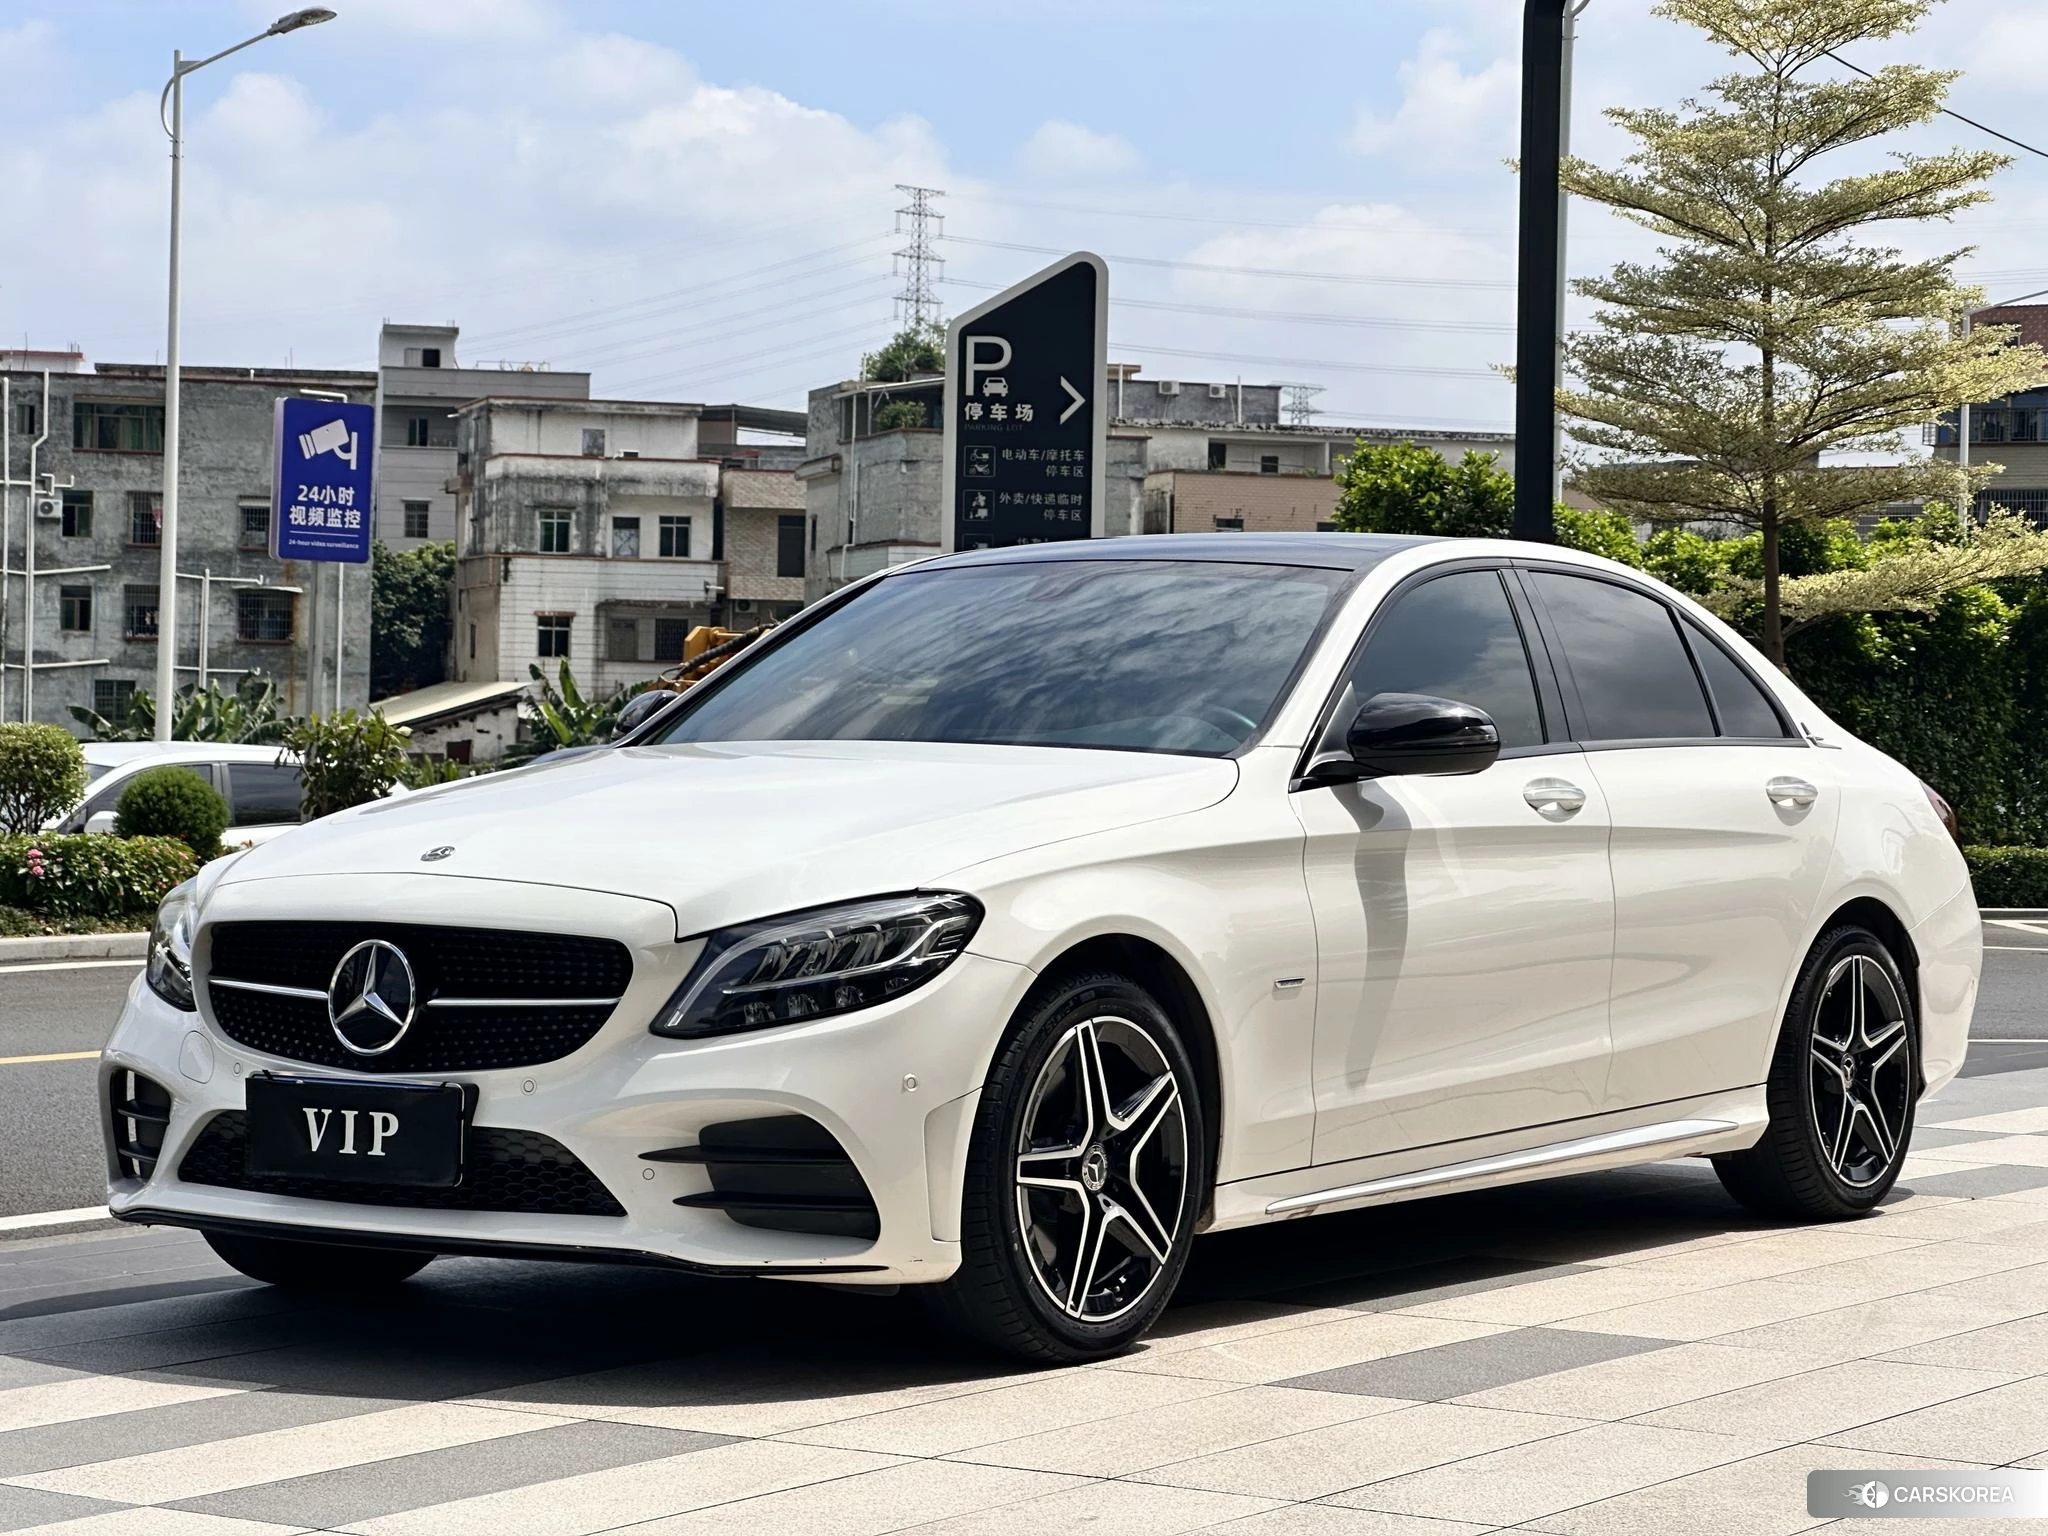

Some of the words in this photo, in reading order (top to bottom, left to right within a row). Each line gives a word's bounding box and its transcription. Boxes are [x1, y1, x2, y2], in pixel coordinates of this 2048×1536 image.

[965, 335, 1012, 396] P
[964, 402, 1034, 422] 停车场
[1002, 449, 1085, 462] 电动车/摩托车
[1046, 465, 1084, 477] 停车区
[297, 485, 355, 506] 24小时
[999, 492, 1083, 506] 外卖/快递临时
[289, 505, 361, 529] 视频监控
[1043, 509, 1082, 521] 停车区
[302, 1107, 399, 1156] VIP
